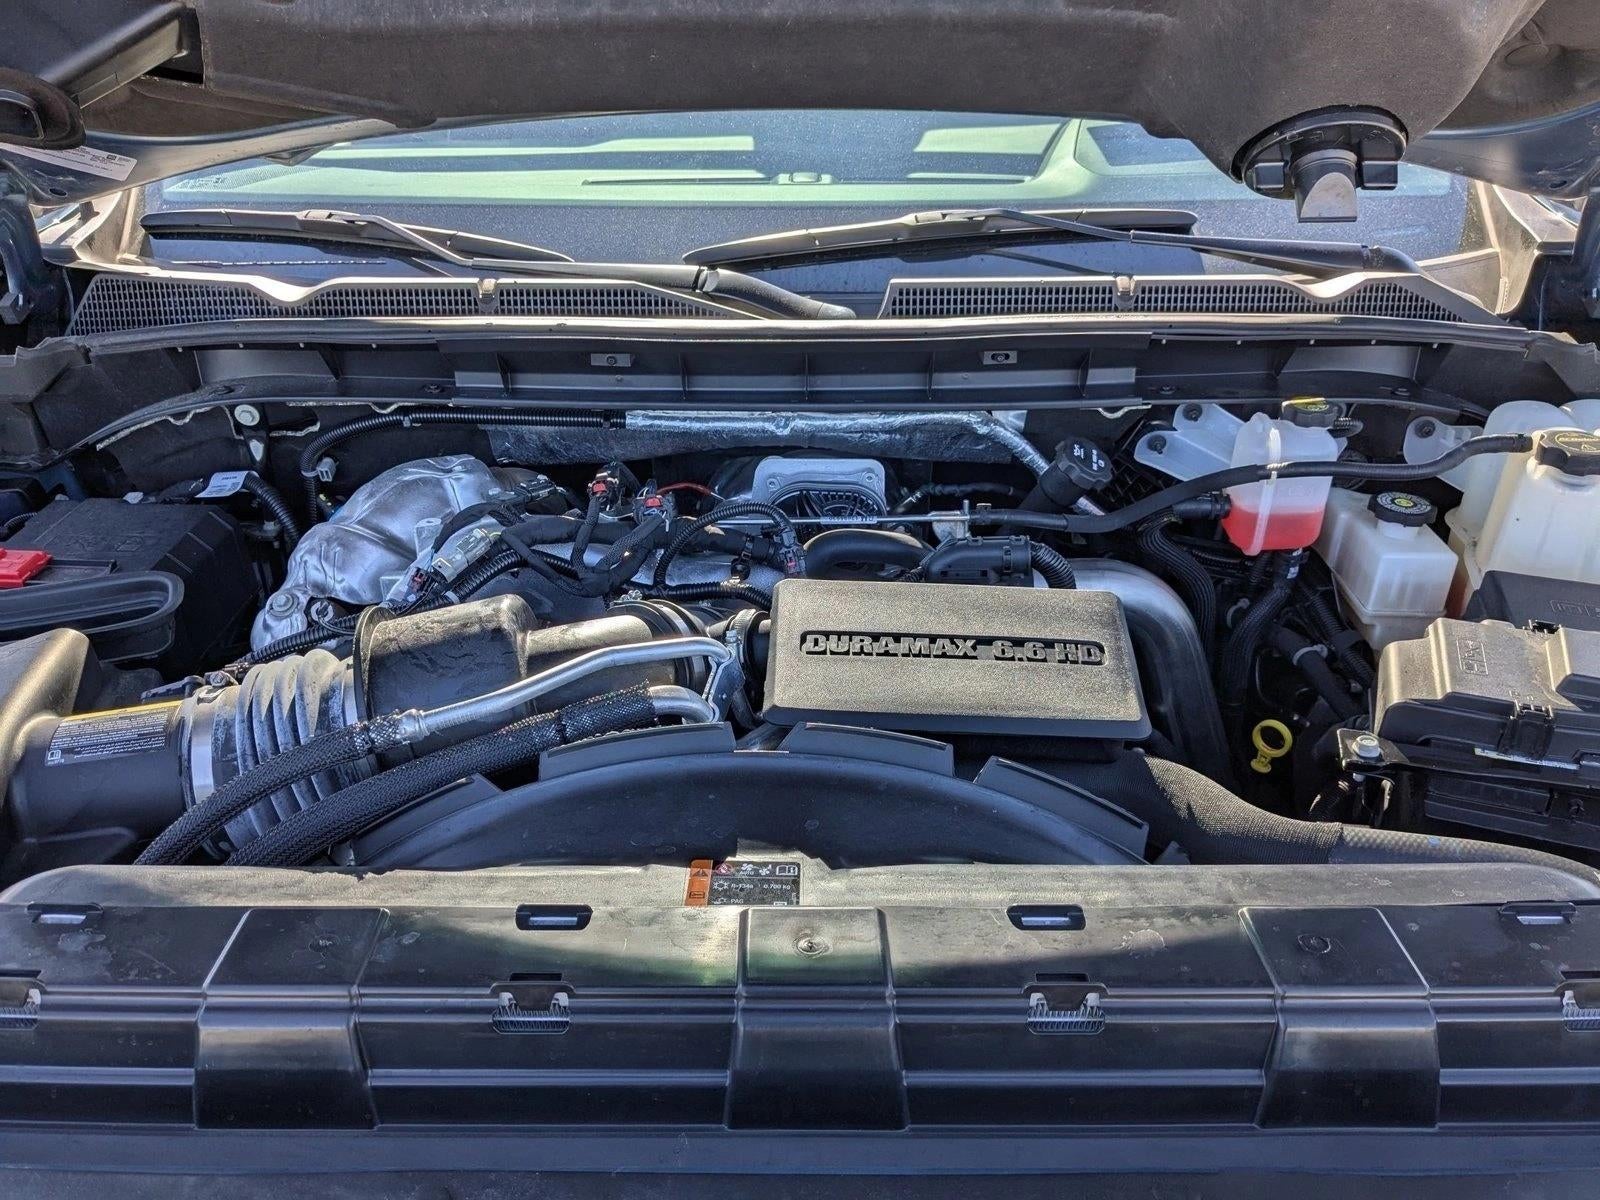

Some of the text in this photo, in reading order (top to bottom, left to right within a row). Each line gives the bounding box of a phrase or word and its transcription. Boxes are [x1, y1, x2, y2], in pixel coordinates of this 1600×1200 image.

[805, 634, 1103, 664] DURAMAX 6.6 HD
